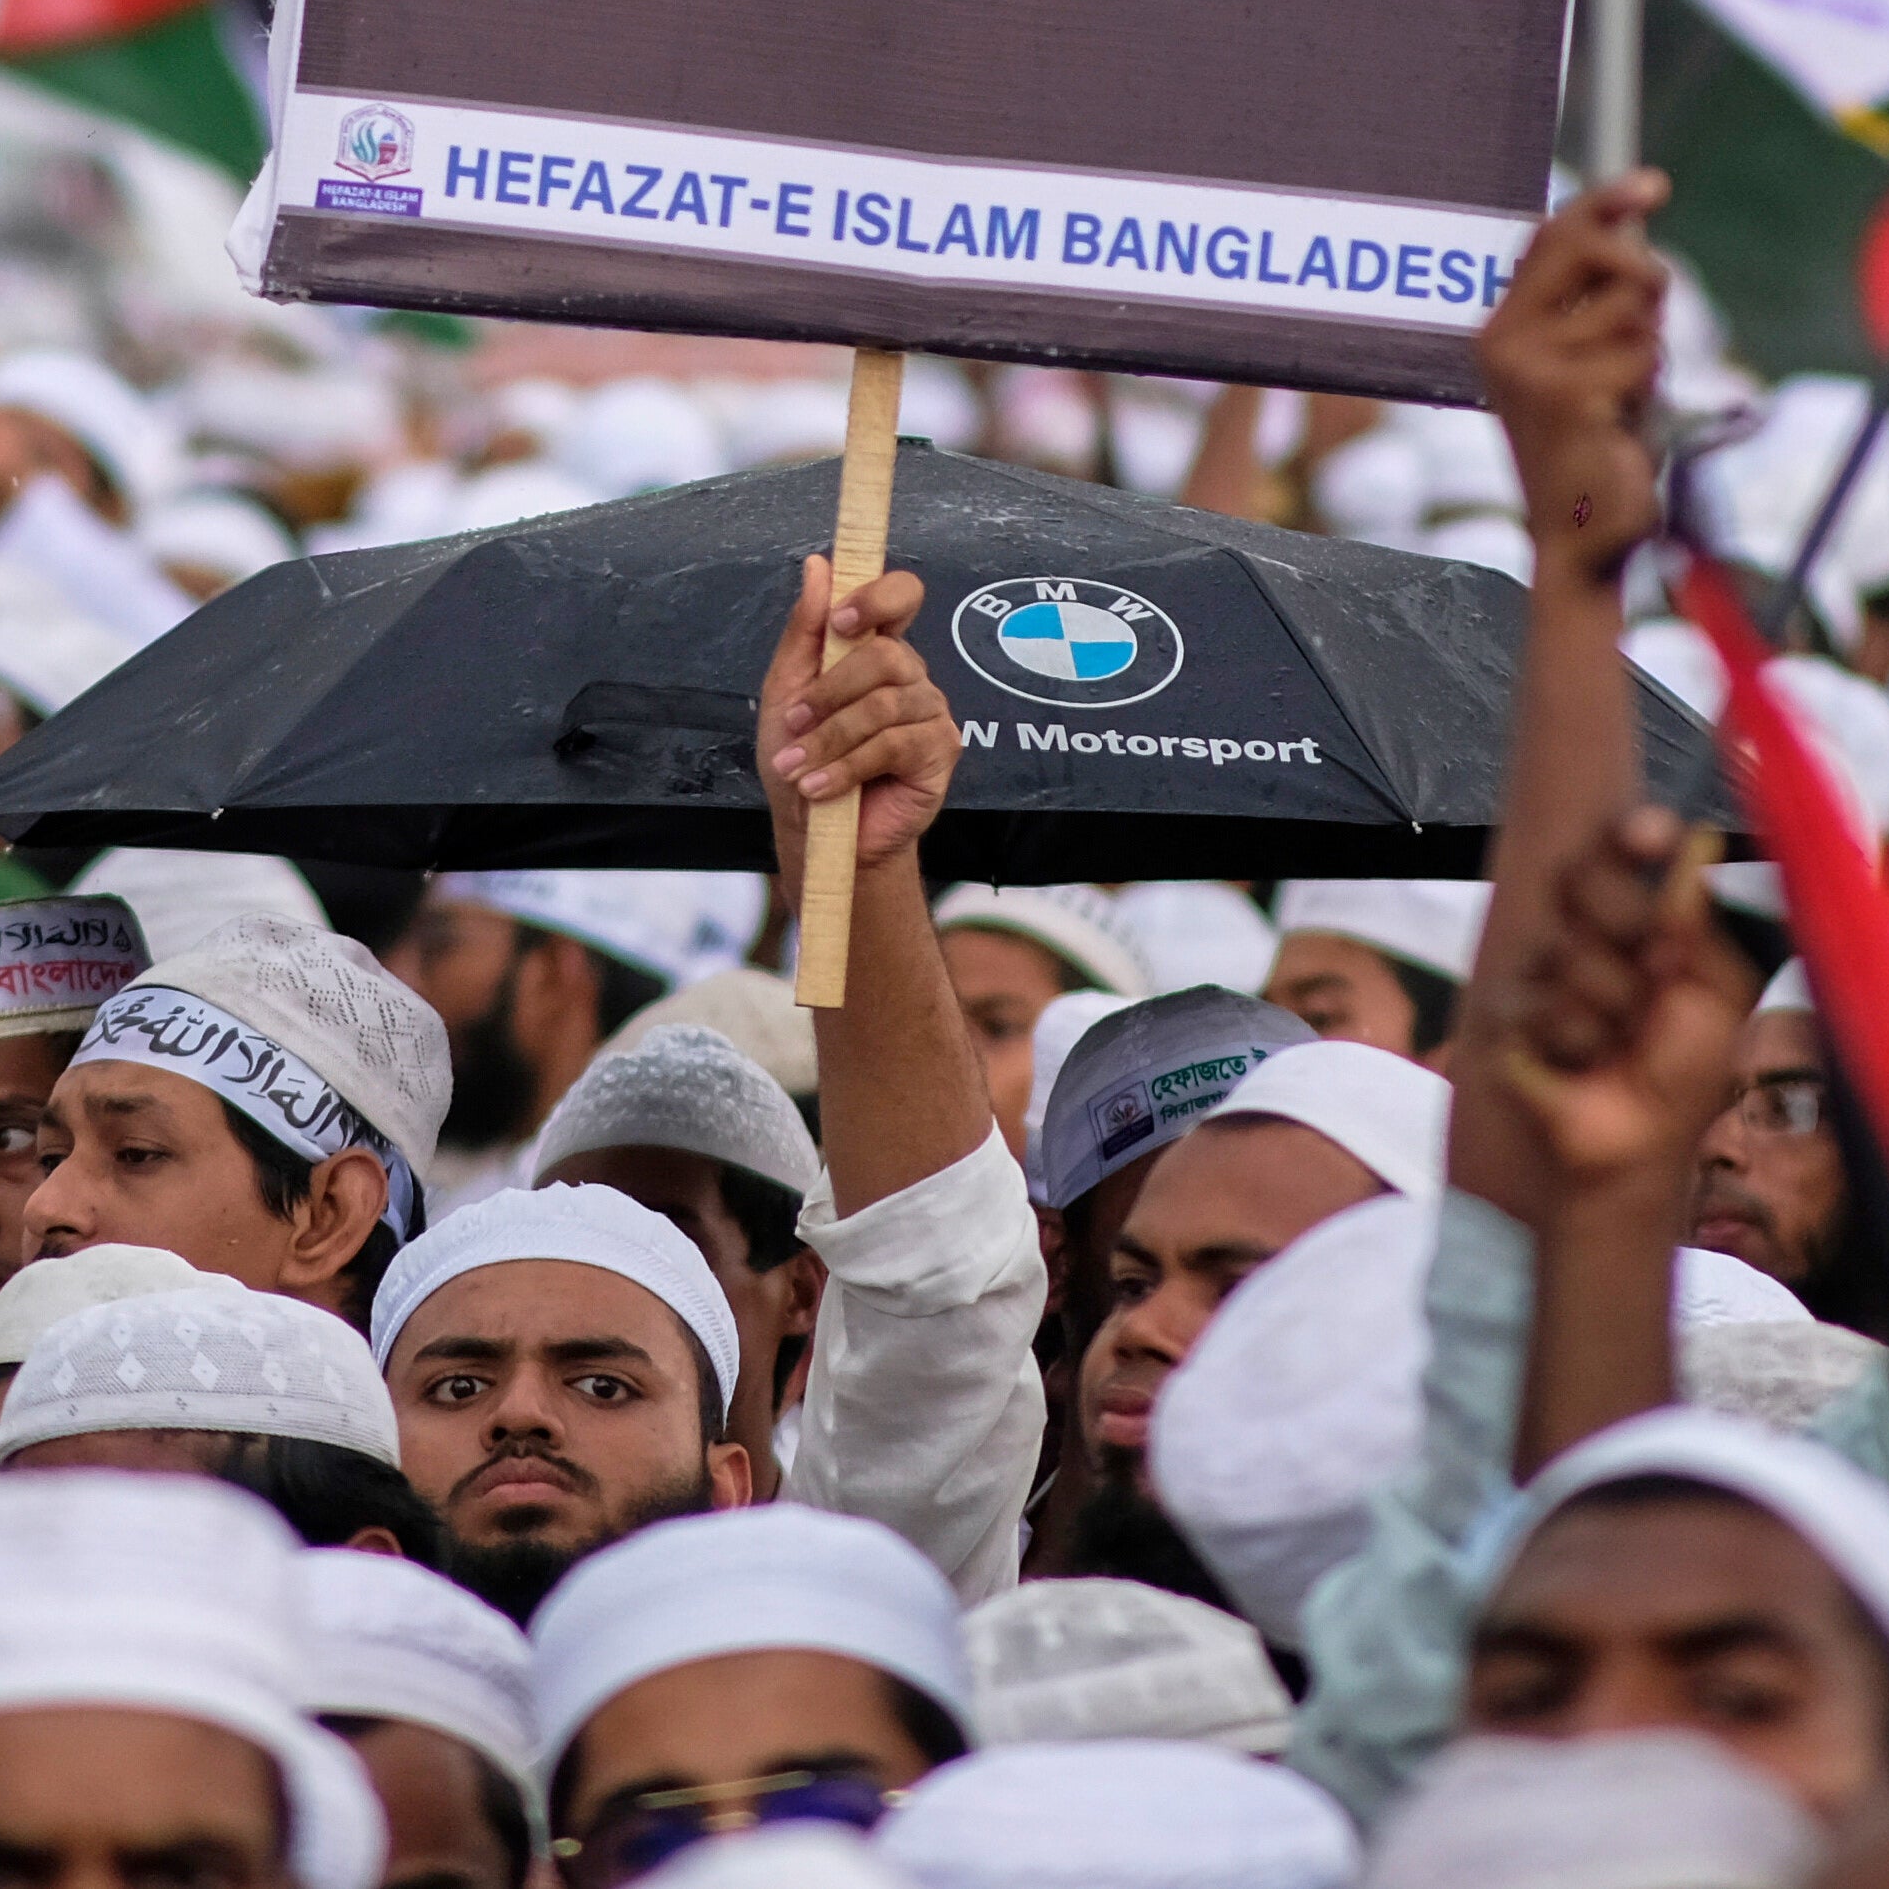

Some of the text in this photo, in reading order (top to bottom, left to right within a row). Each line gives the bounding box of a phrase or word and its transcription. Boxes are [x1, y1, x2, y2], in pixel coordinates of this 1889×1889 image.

[322, 183, 420, 203] HEFAZAT-E ISLAM
[331, 196, 408, 213] BANGLADESH
[446, 145, 1511, 308] HEFAZAT-E ISLAM BANGLADESH
[971, 581, 1155, 623] BMW
[1016, 722, 1322, 766] Motorsport
[1152, 1055, 1248, 1100] হেফাজতে
